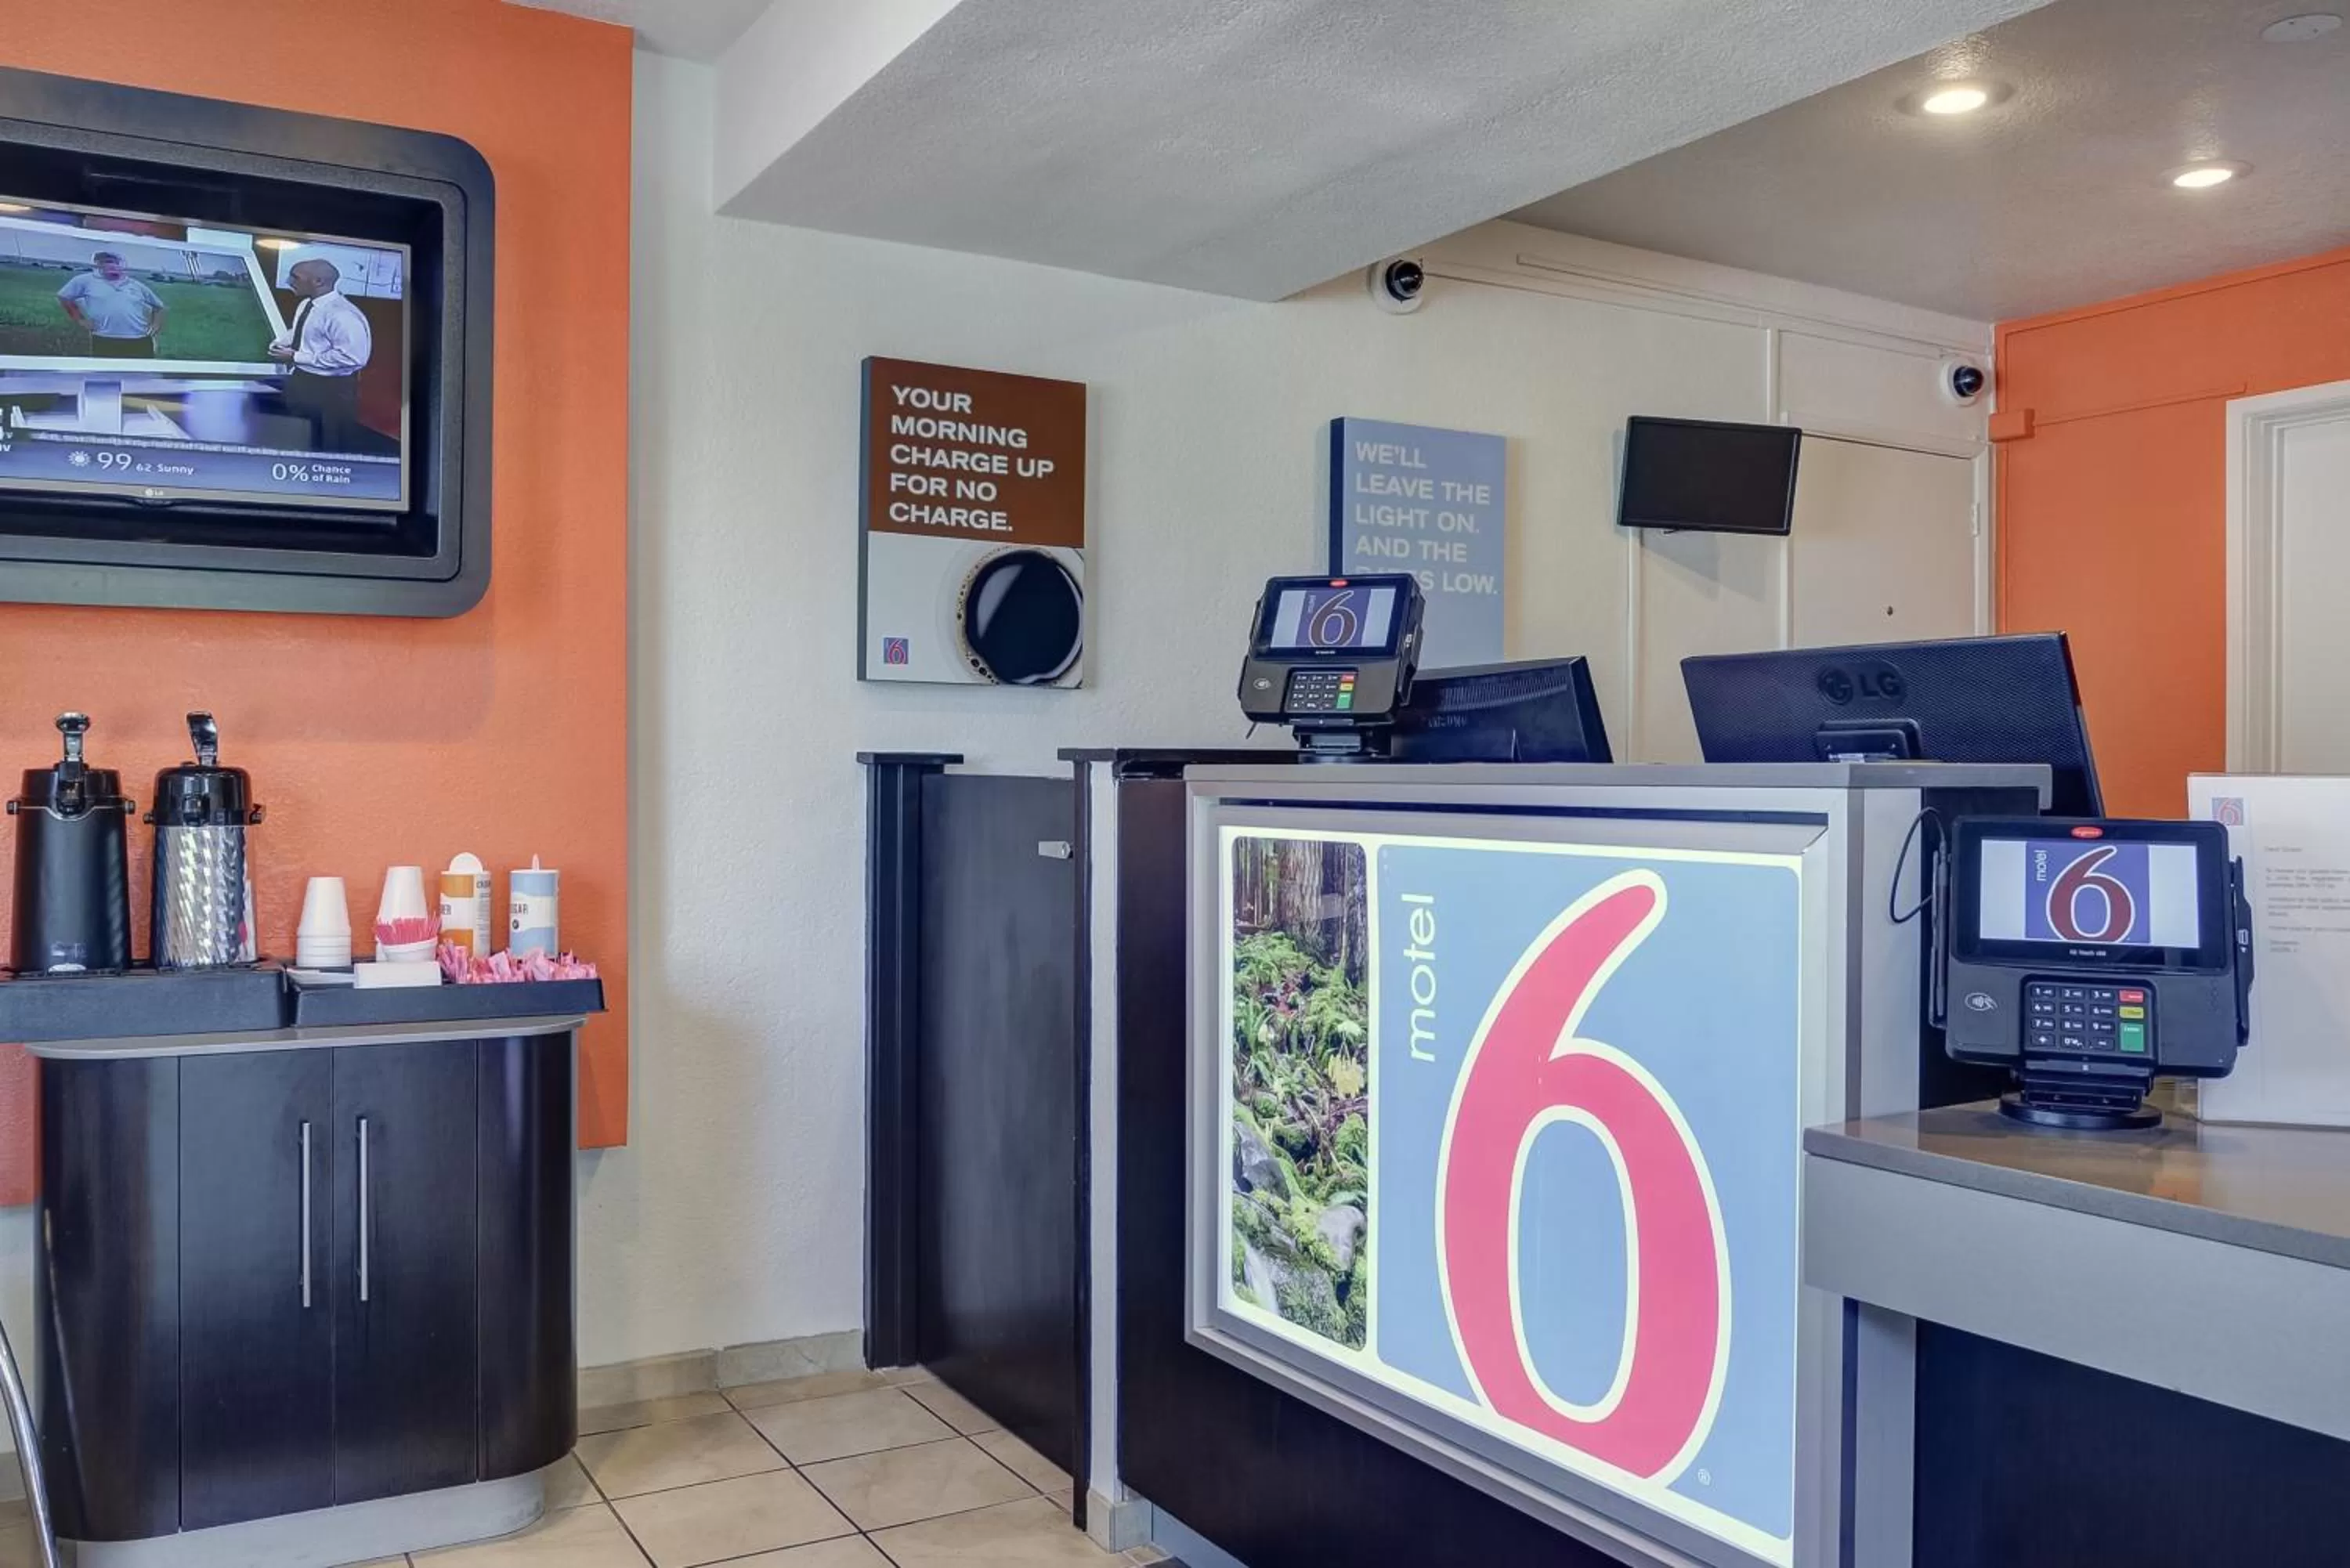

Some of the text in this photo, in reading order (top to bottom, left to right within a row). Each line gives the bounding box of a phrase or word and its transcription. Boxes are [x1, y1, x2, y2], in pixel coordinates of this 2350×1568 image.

[891, 385, 972, 414] YOUR
[891, 414, 1028, 449] MORNING
[97, 452, 132, 470] 99
[157, 463, 194, 476] Sunny
[312, 464, 351, 474] Chance
[891, 443, 1054, 479] CHARGE UP
[1355, 441, 1427, 469] WE'LL
[272, 463, 309, 482] 0%
[325, 475, 351, 483] Rain
[890, 472, 997, 502] FOR NO
[1356, 473, 1491, 505] LEAVE THE
[889, 502, 1014, 532] CHARGE.
[1356, 504, 1480, 533] LIGHT ON.
[1355, 535, 1467, 563] AND THE
[1442, 570, 1499, 594] LOW.
[1308, 590, 1358, 647] 6
[1858, 670, 1900, 697] LG
[2034, 844, 2136, 943] motel 6
[1401, 892, 1436, 1063] motel
[1434, 868, 1733, 1490] 6
